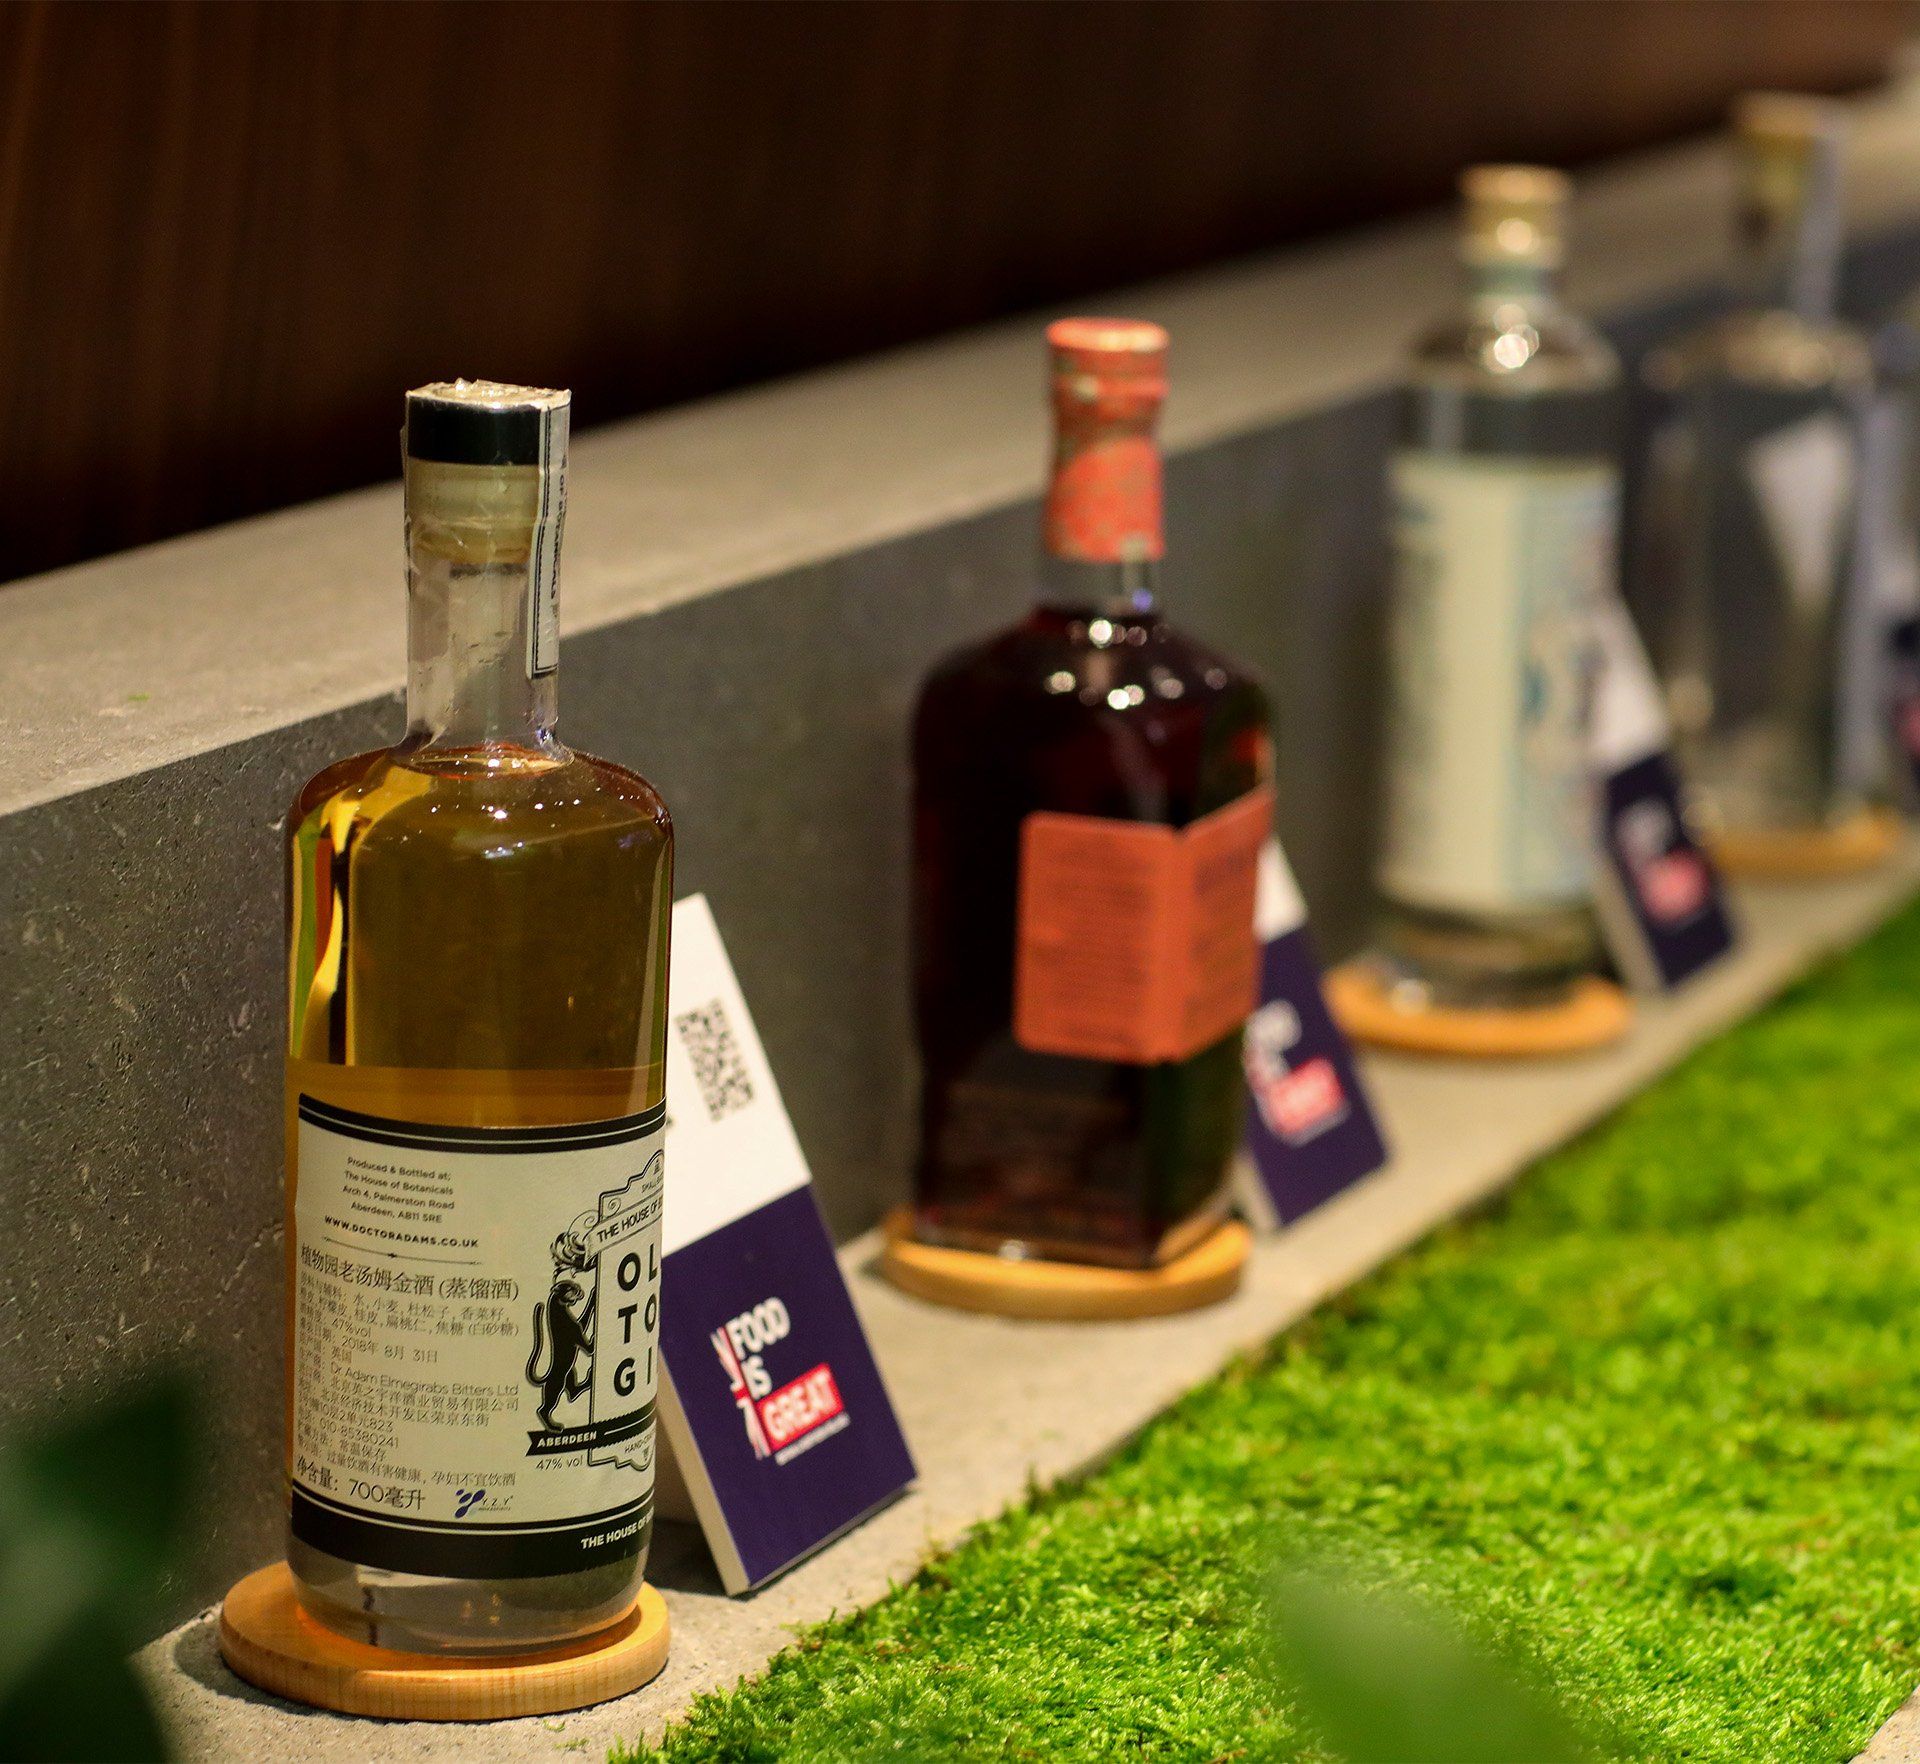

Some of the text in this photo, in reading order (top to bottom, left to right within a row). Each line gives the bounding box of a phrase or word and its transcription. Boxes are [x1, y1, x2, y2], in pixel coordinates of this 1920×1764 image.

[345, 1170, 454, 1196] The House of Botanicals
[347, 1157, 387, 1173] Produced
[390, 1166, 396, 1174] &
[399, 1167, 435, 1180] Bottled
[342, 1185, 361, 1197] Arch
[374, 1191, 426, 1208] Palmerston
[428, 1201, 455, 1210] Road
[351, 1202, 395, 1219] Aberdeen,
[397, 1211, 420, 1222] AB11
[324, 1214, 478, 1249] WWW.DOCTORADAMS.CO.UK
[596, 1223, 619, 1243] THE
[621, 1205, 649, 1231] HOUSE
[725, 1297, 791, 1361] FOOD
[344, 1367, 378, 1384] Adam
[452, 1383, 493, 1396] Bitters
[496, 1384, 518, 1397] Ltd
[741, 1354, 773, 1400] IS
[763, 1367, 841, 1441] GREAT
[537, 1430, 597, 1448] ABERDEEN
[535, 1454, 583, 1470] 47% vol
[349, 1478, 426, 1511] 700毫升
[580, 1535, 605, 1550] THE
[605, 1521, 638, 1544] HOUSE
